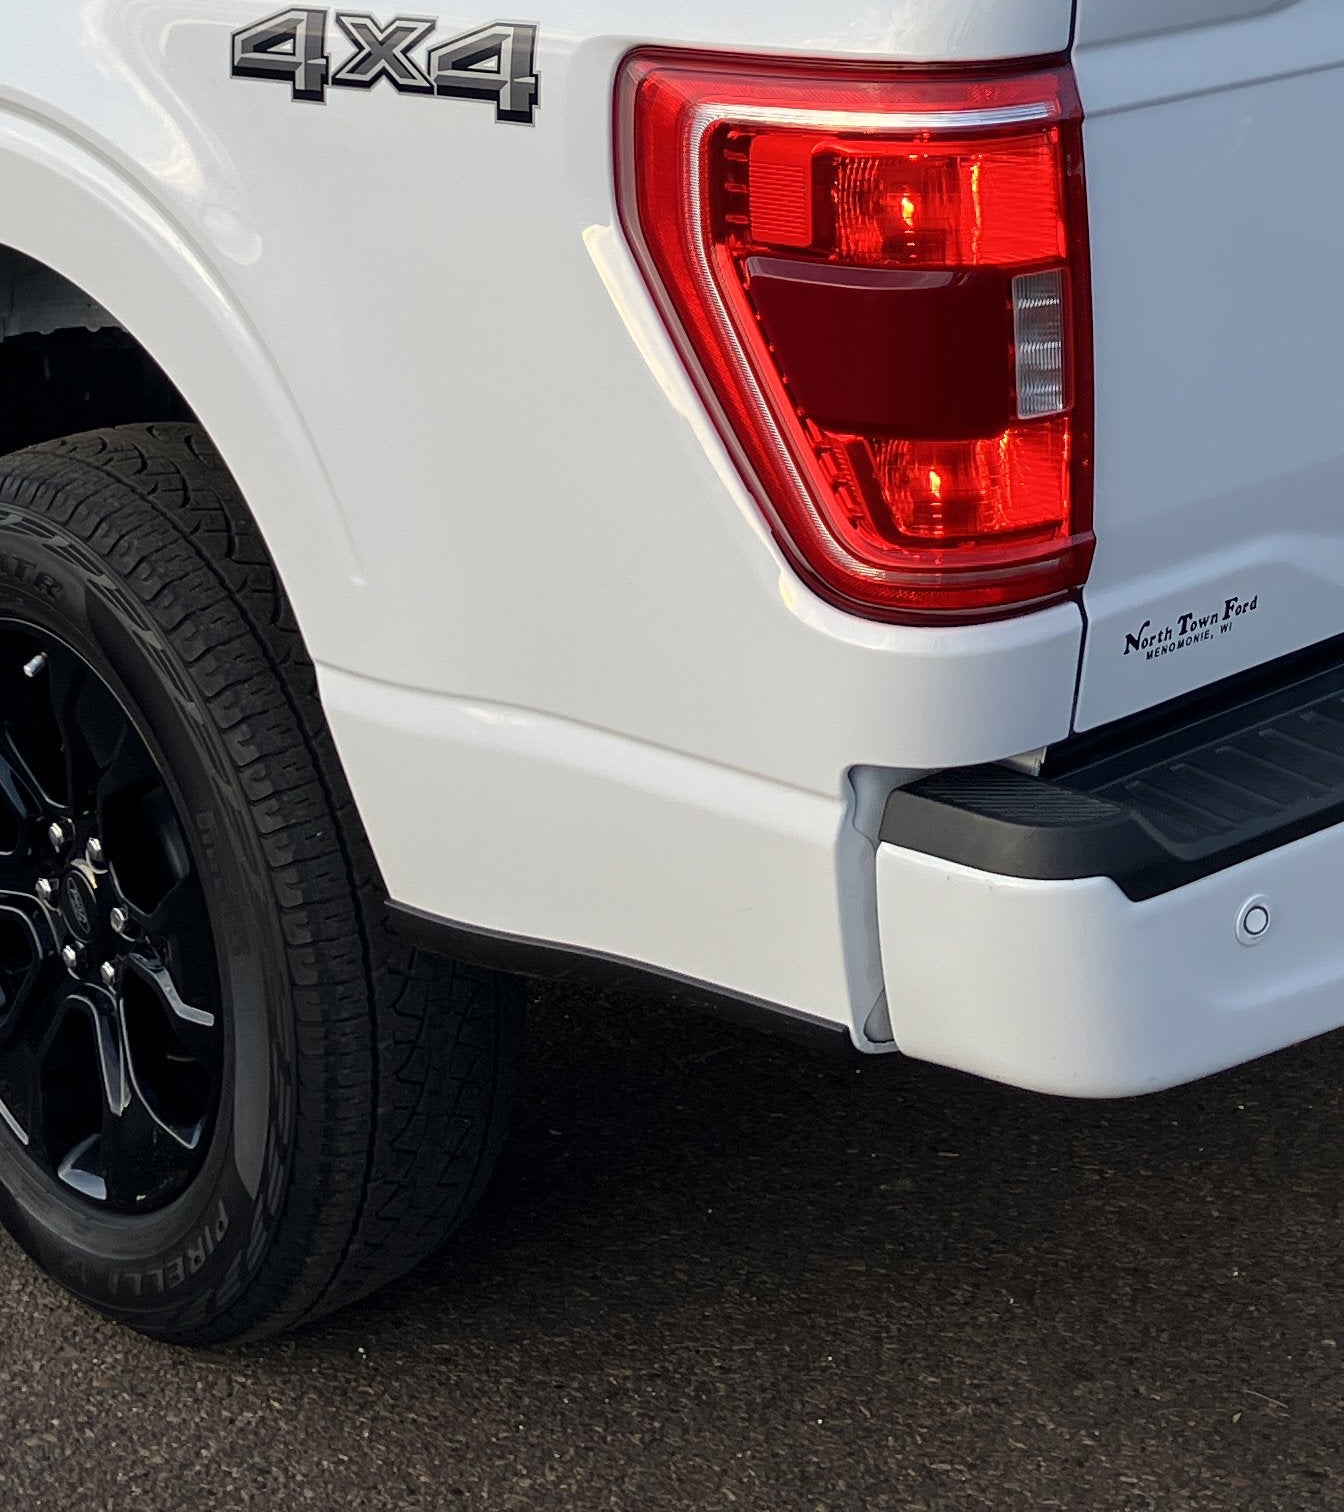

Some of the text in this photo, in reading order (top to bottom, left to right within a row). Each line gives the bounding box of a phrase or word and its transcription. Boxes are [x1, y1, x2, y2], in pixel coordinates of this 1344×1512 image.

[1123, 594, 1258, 655] North Town Ford
[1219, 622, 1233, 634] WI
[108, 1198, 230, 1296] PIRELLI
